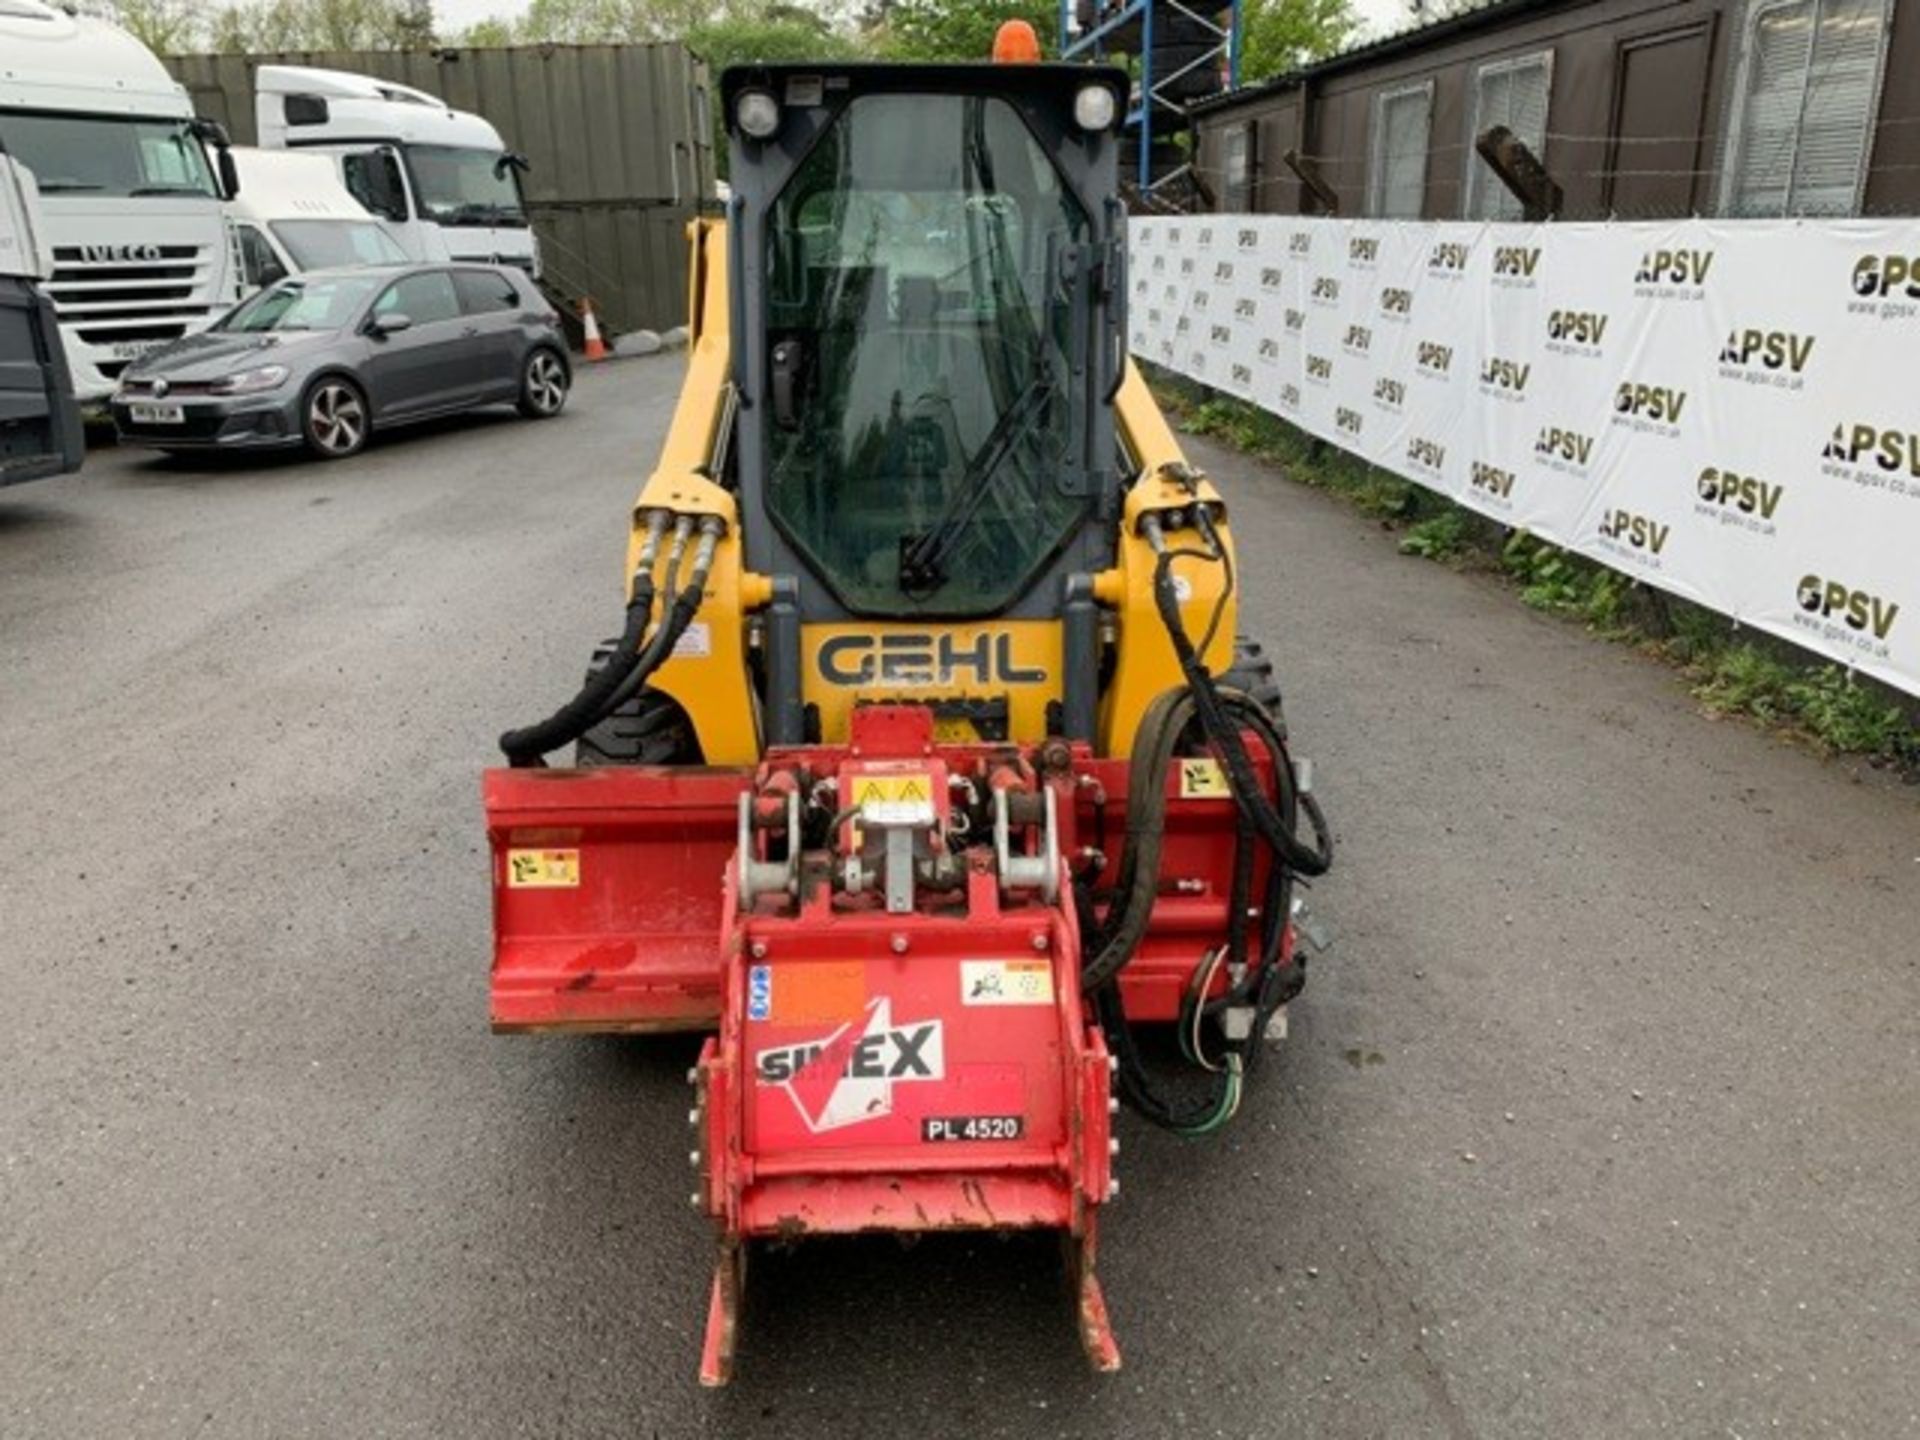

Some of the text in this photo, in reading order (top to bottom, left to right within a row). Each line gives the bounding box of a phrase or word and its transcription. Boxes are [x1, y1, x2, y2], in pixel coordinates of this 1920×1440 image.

[82, 246, 161, 261] IVECO
[1634, 248, 1714, 285] APSV
[1718, 328, 1815, 372] APSV
[1613, 381, 1687, 424] GPSV
[1697, 466, 1783, 519] GPSV
[1796, 574, 1899, 640] GPSV
[818, 633, 1047, 685] GEHL
[928, 1119, 1018, 1139] PL 4520
